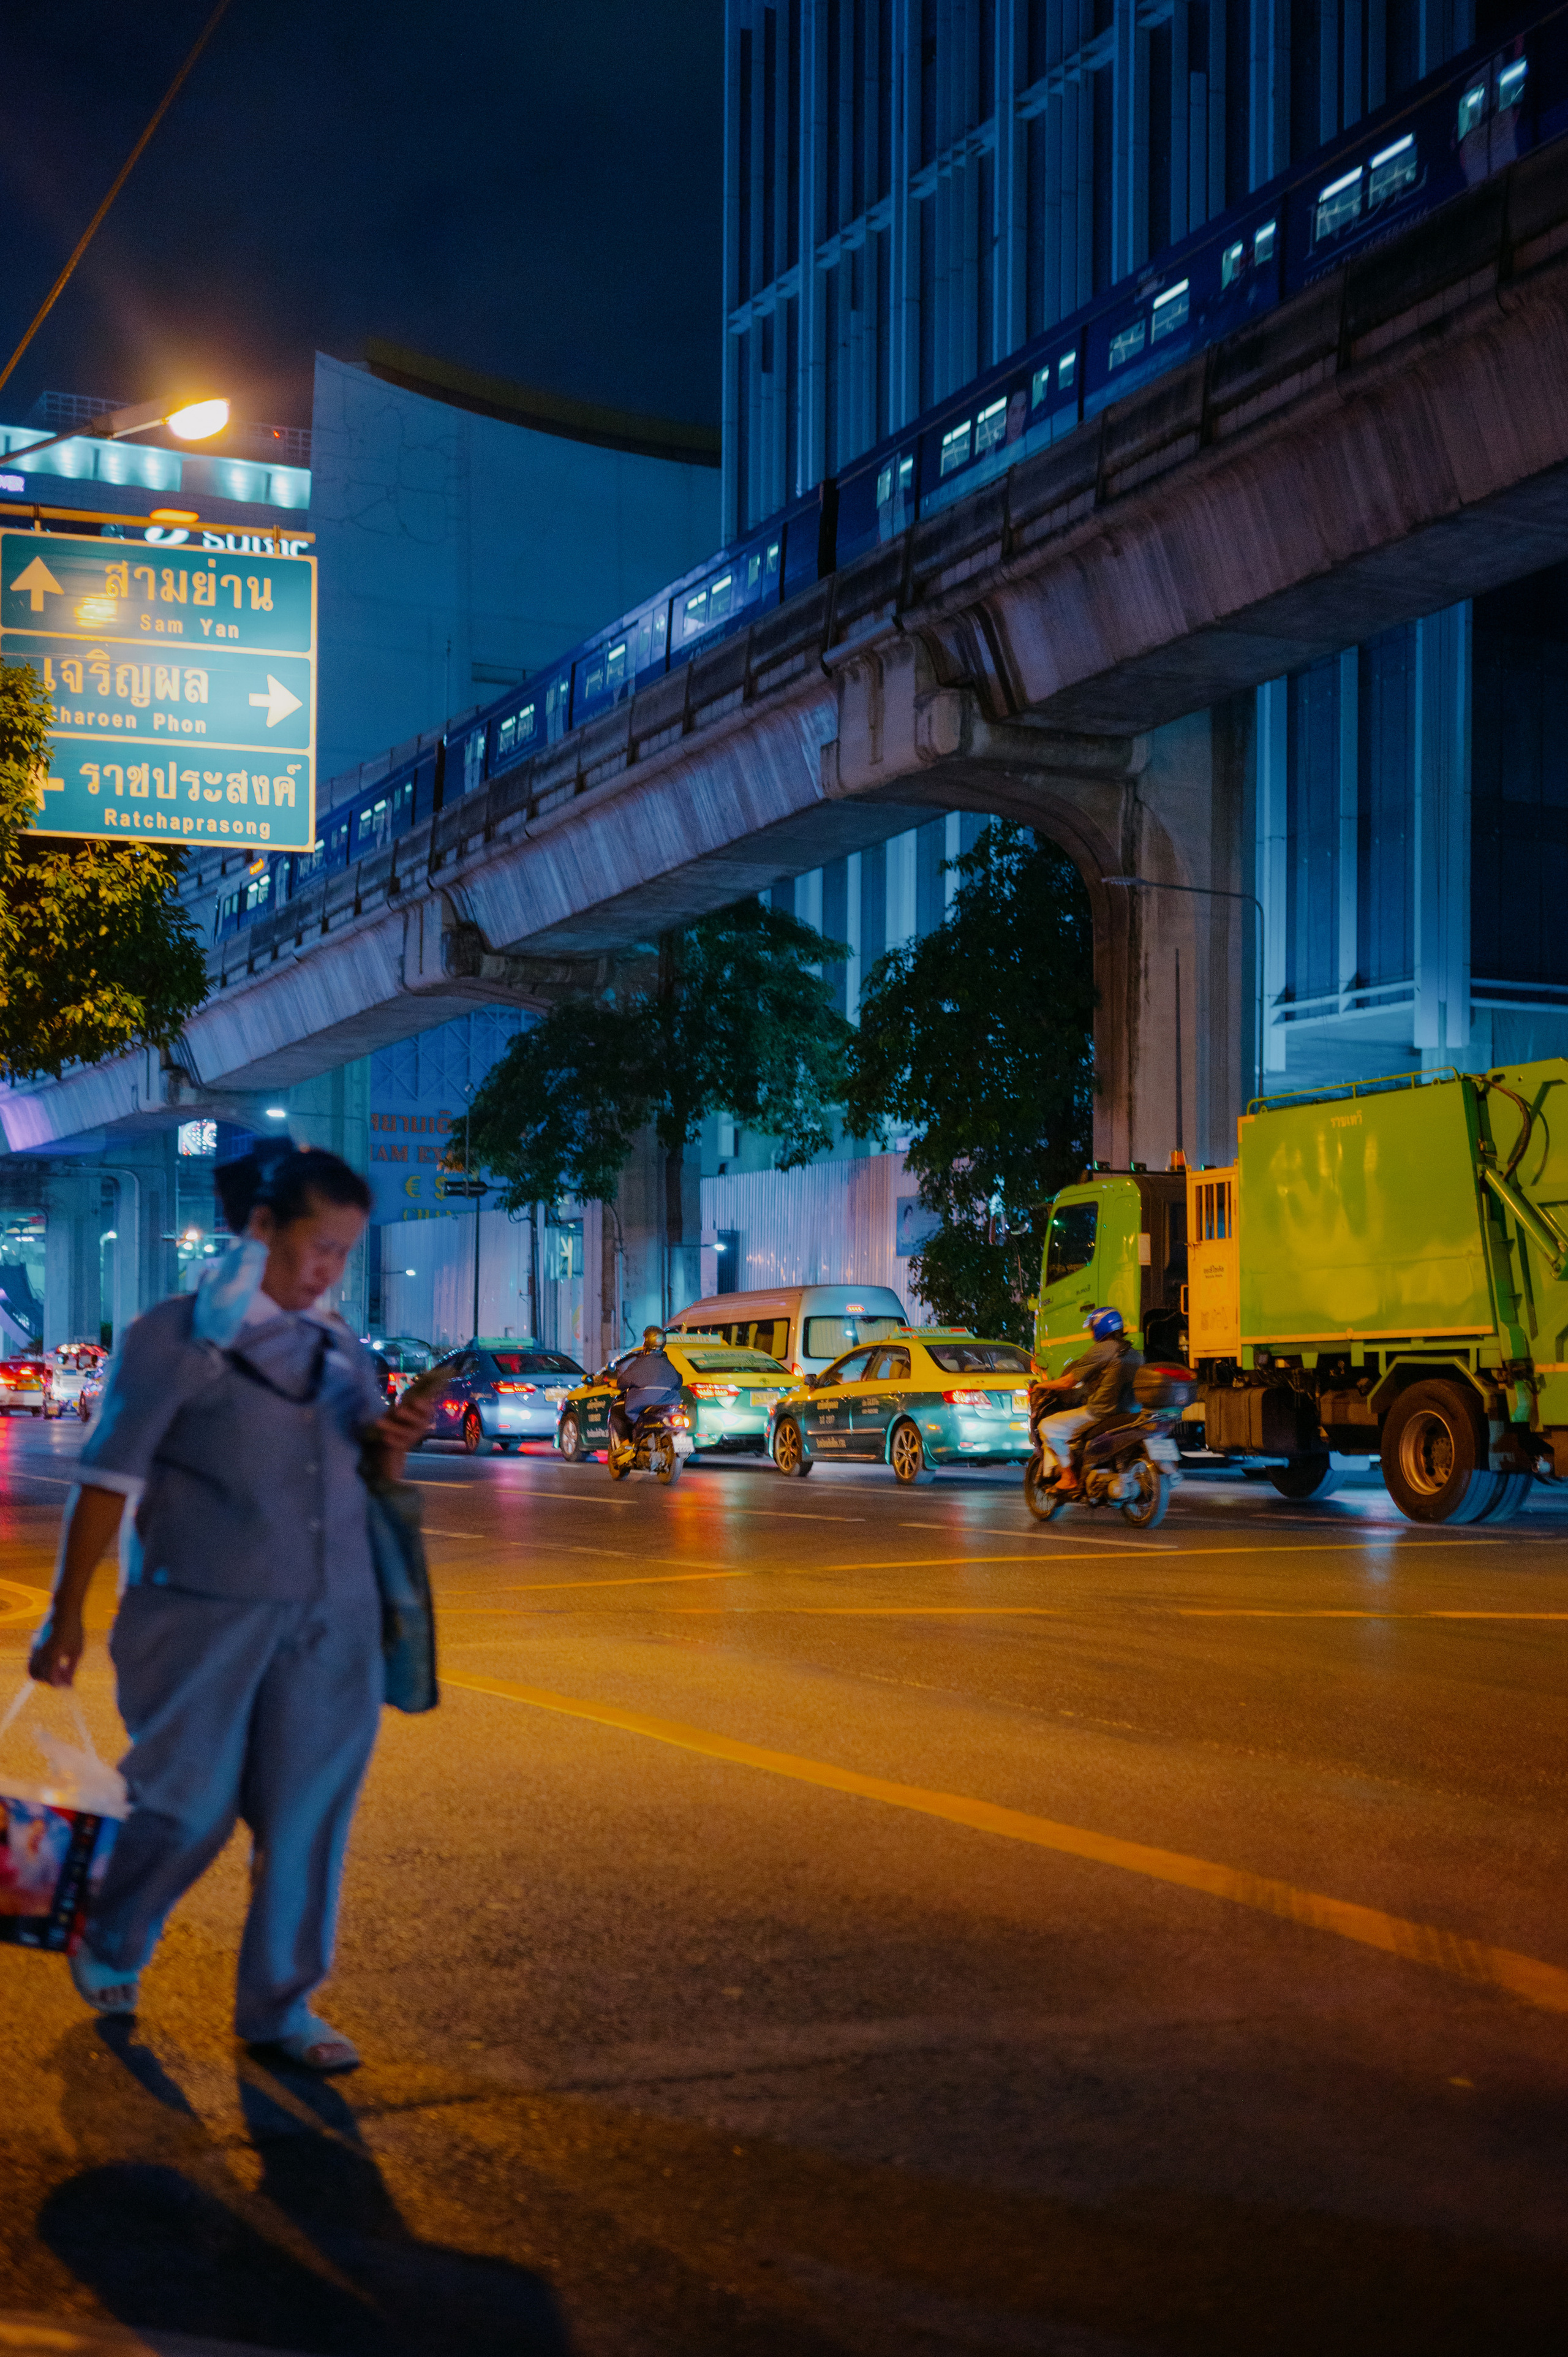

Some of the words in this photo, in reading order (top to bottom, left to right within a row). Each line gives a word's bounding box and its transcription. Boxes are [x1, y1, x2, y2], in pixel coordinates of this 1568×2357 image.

[105, 558, 274, 611] สามย่าน
[140, 614, 183, 634] Sam
[200, 618, 239, 638] Yan
[43, 648, 209, 708] เจริญผล
[153, 713, 207, 734] Phon
[79, 761, 302, 808] ราชประสงค์
[104, 808, 271, 840] Ratchaprasong
